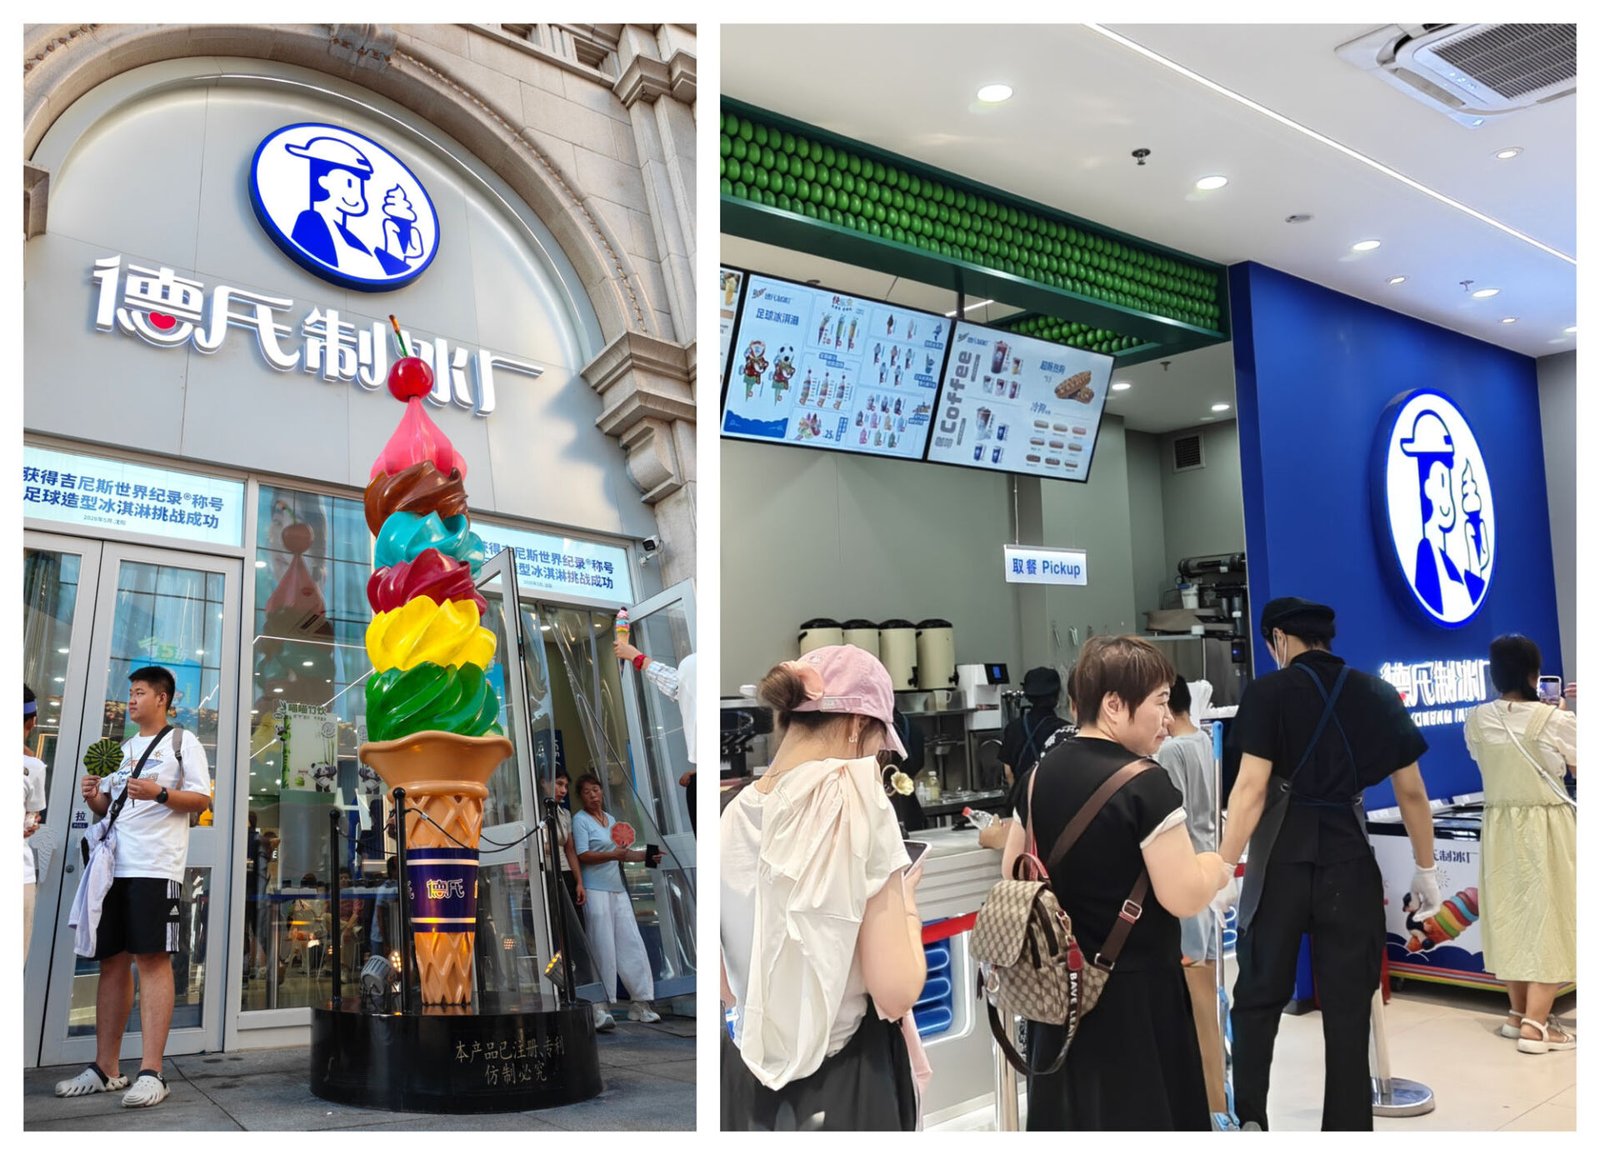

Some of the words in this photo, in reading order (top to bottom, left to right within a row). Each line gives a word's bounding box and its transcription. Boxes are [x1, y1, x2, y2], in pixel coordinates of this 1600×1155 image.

[92, 255, 544, 417] 德氏制冰厂
[940, 351, 973, 434] Coffee
[23, 465, 225, 513] 获得吉尼斯世界纪录®称号
[23, 486, 219, 530] 足球造型冰淇淋挑战成功
[1012, 557, 1037, 576] 取餐
[1042, 560, 1081, 579] Pickup
[75, 810, 87, 822] 拉
[426, 878, 466, 900] 德氏
[484, 1060, 548, 1086] 仿制必究
